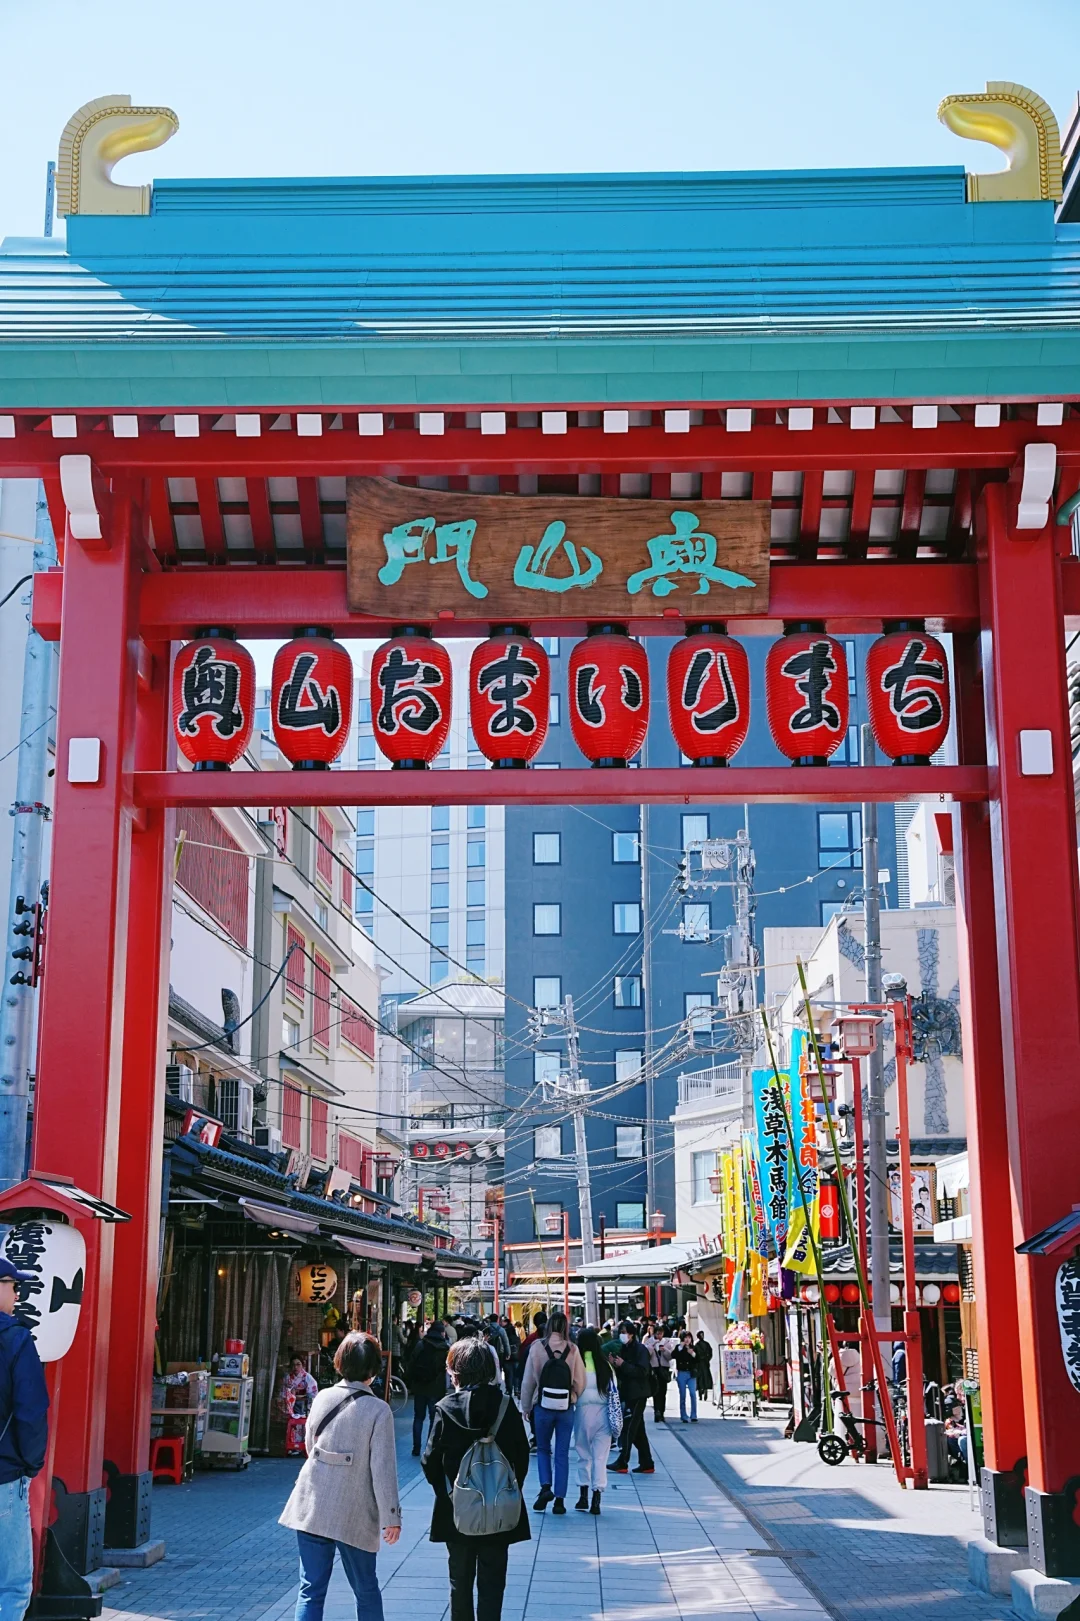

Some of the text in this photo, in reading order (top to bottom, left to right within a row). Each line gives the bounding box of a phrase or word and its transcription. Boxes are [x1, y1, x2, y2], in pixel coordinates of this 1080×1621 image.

[760, 1086, 788, 1220] 浅草木馬館
[309, 1266, 327, 1301] にこみ
